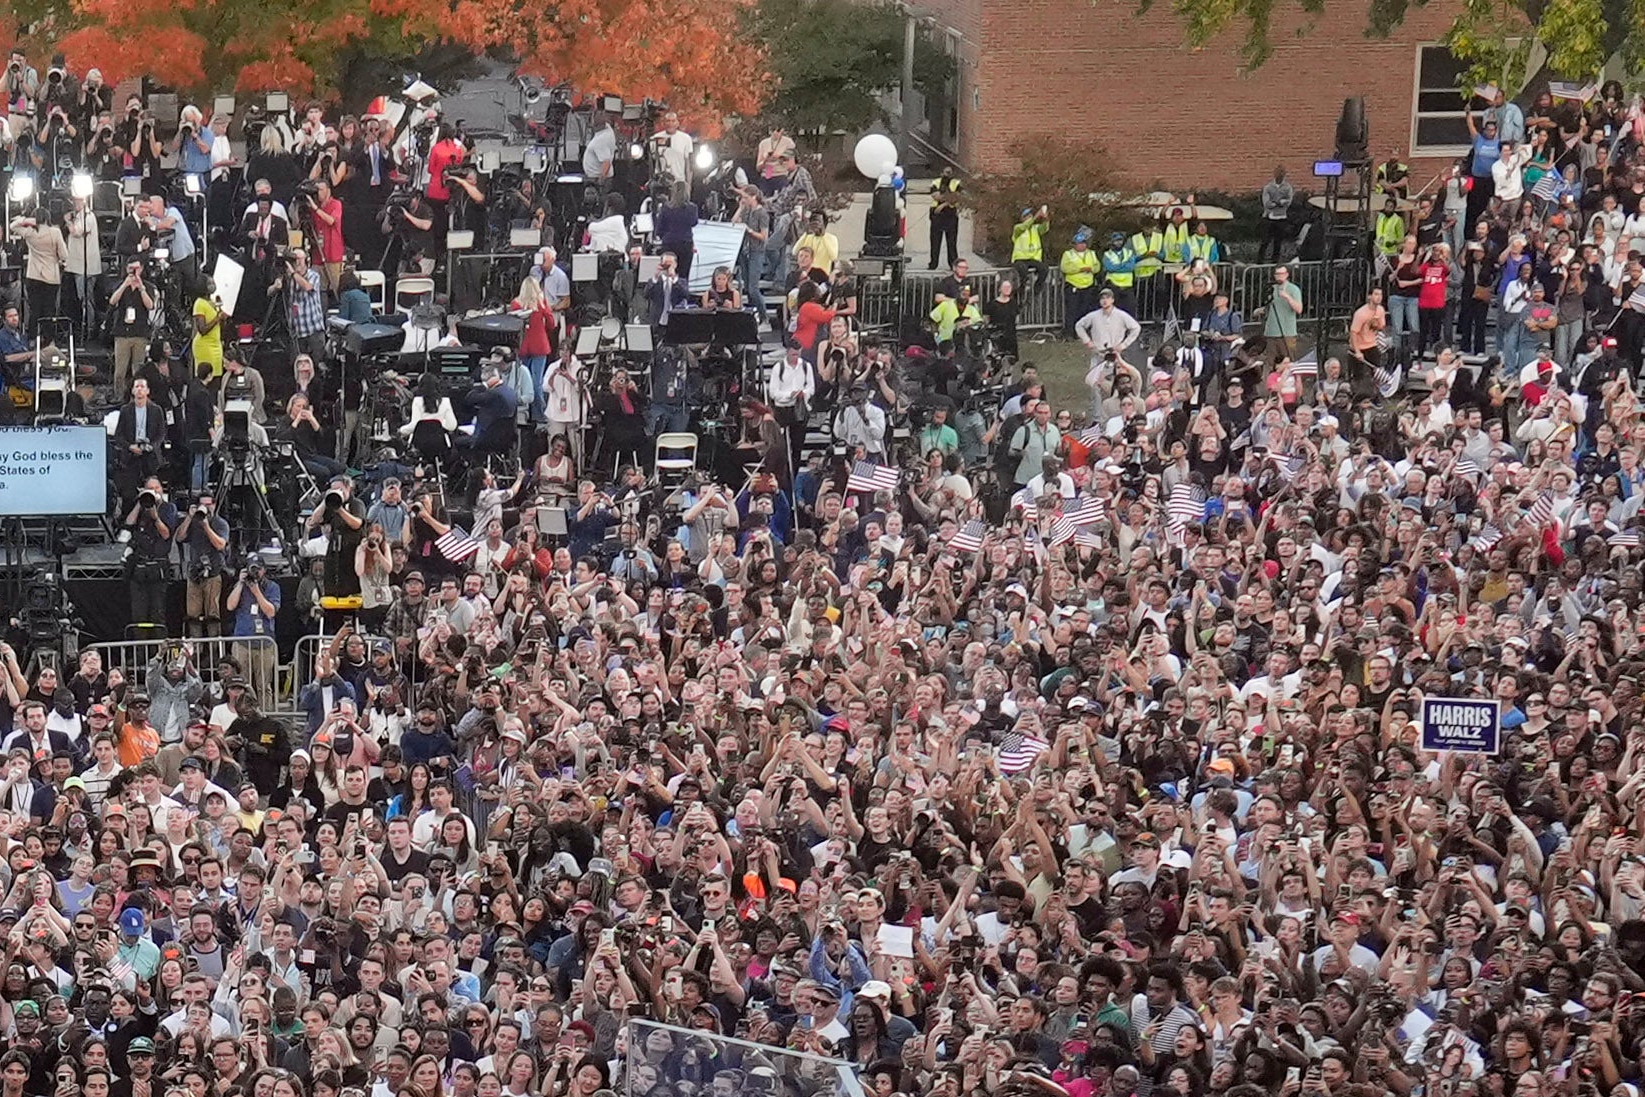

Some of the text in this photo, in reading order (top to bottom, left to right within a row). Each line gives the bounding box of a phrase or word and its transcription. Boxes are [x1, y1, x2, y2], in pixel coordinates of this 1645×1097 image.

[12, 451, 37, 461] God
[40, 450, 71, 461] bless
[74, 450, 93, 460] the
[0, 465, 36, 476] States
[38, 464, 51, 475] of
[1429, 704, 1492, 728] HARRIS
[1437, 725, 1482, 739] WALZ
